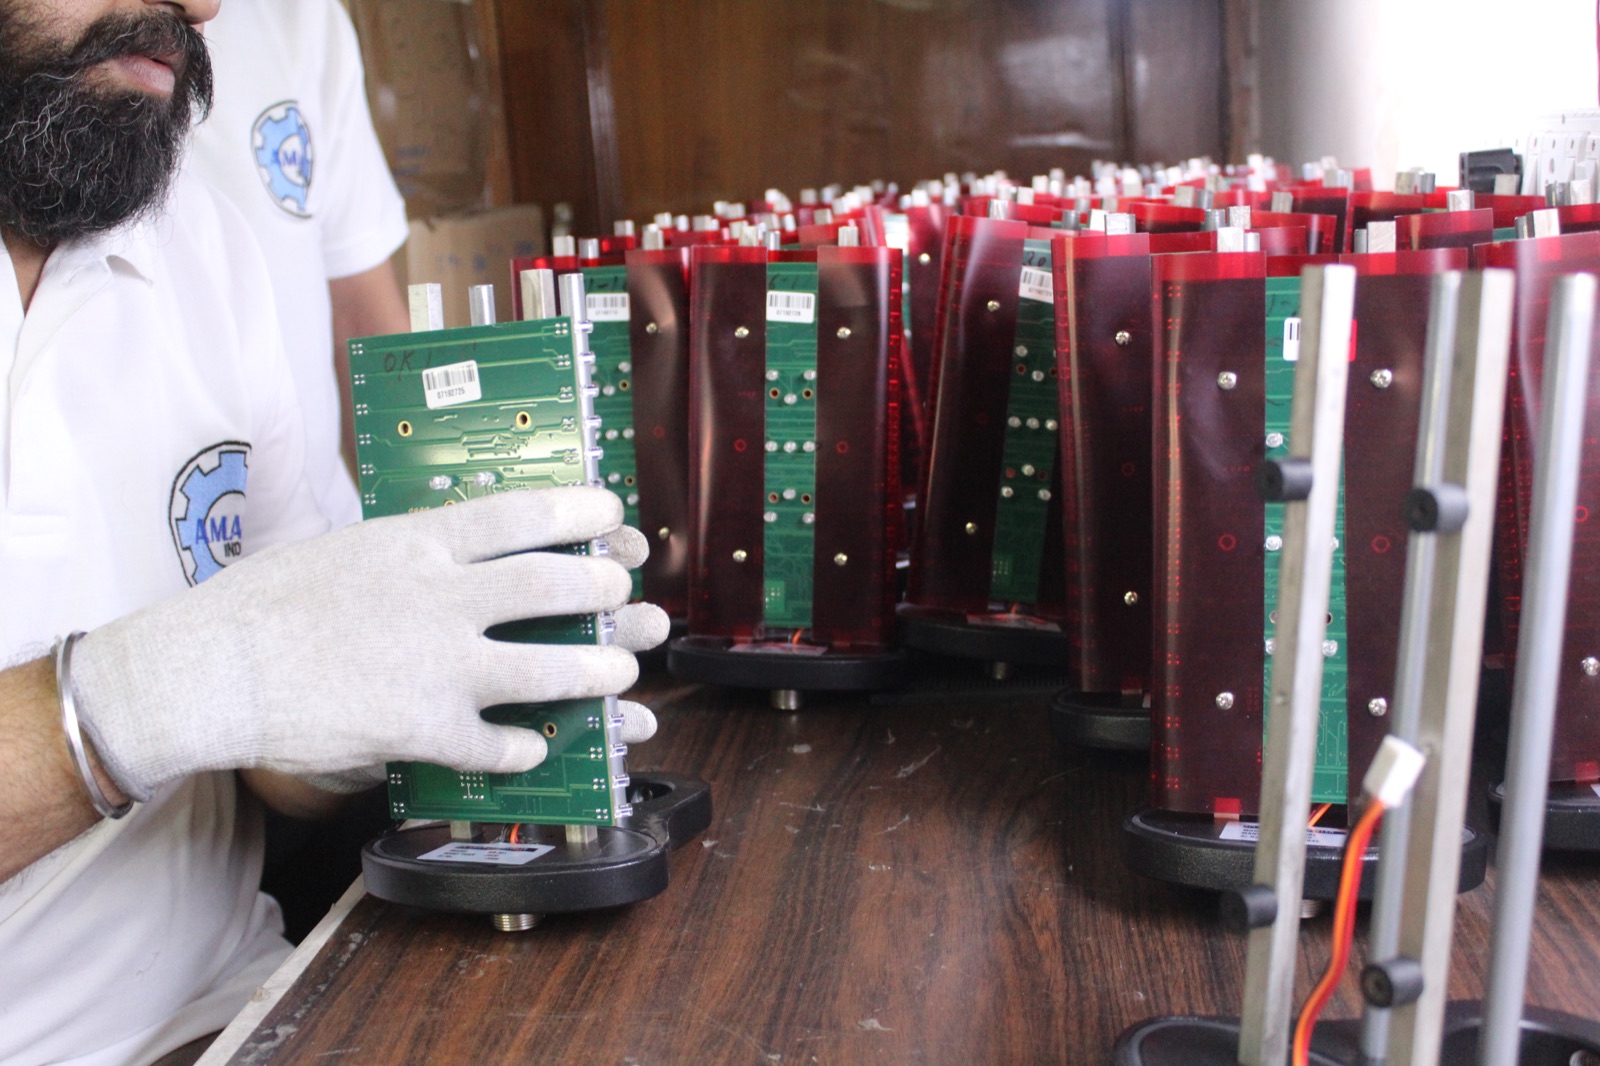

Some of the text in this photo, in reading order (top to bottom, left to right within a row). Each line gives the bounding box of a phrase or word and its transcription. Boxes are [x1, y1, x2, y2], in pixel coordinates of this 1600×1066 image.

[437, 386, 466, 400] 07192725
[195, 514, 242, 545] AMA
[224, 541, 242, 558] IND
